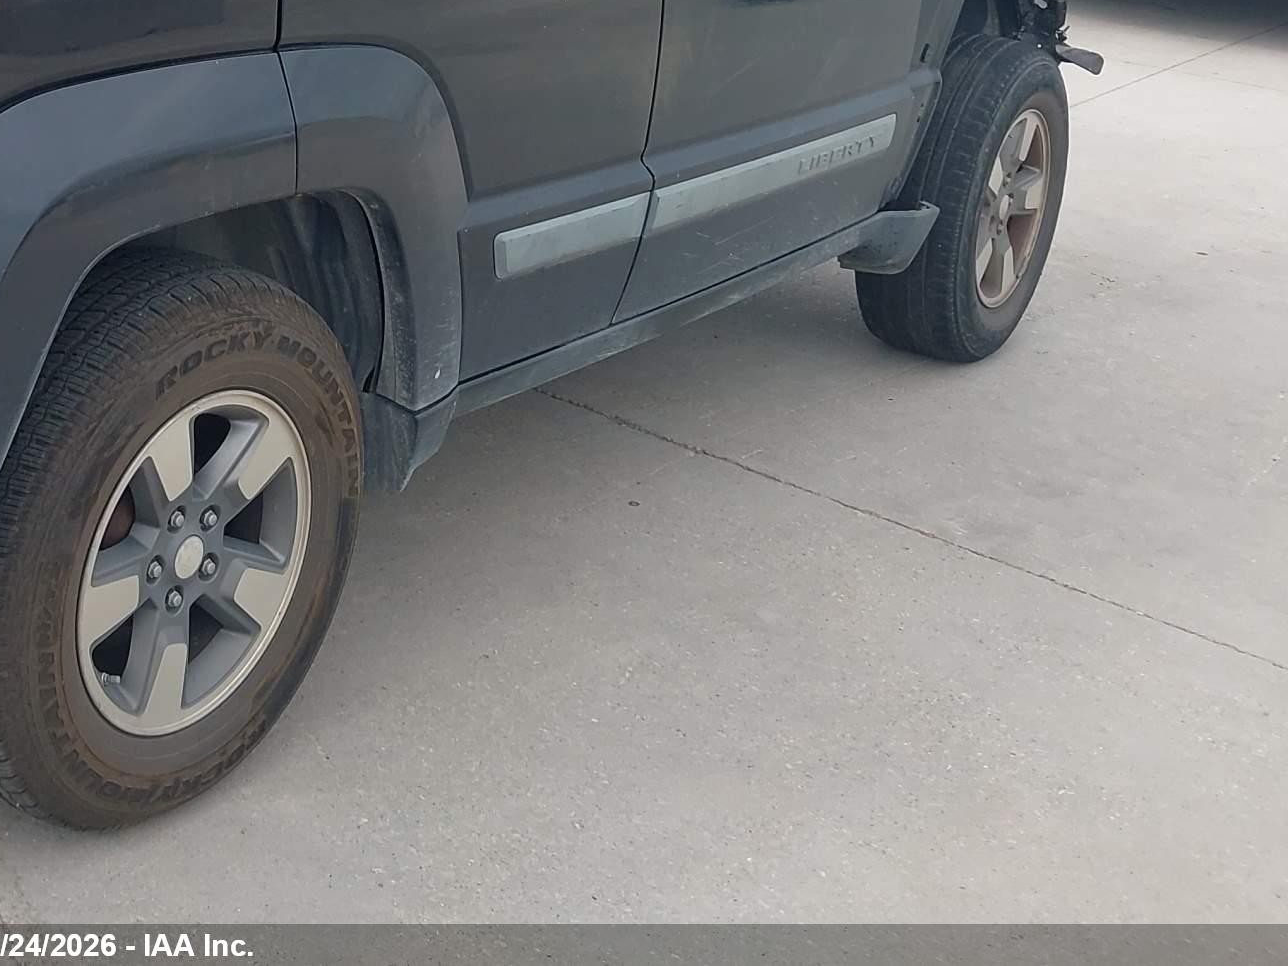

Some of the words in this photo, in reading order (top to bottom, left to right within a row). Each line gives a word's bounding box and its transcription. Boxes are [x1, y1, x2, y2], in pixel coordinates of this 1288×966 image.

[797, 134, 875, 175] LIBERTY
[155, 330, 274, 402] ROCKY
[276, 335, 360, 498] MOUNTAIN
